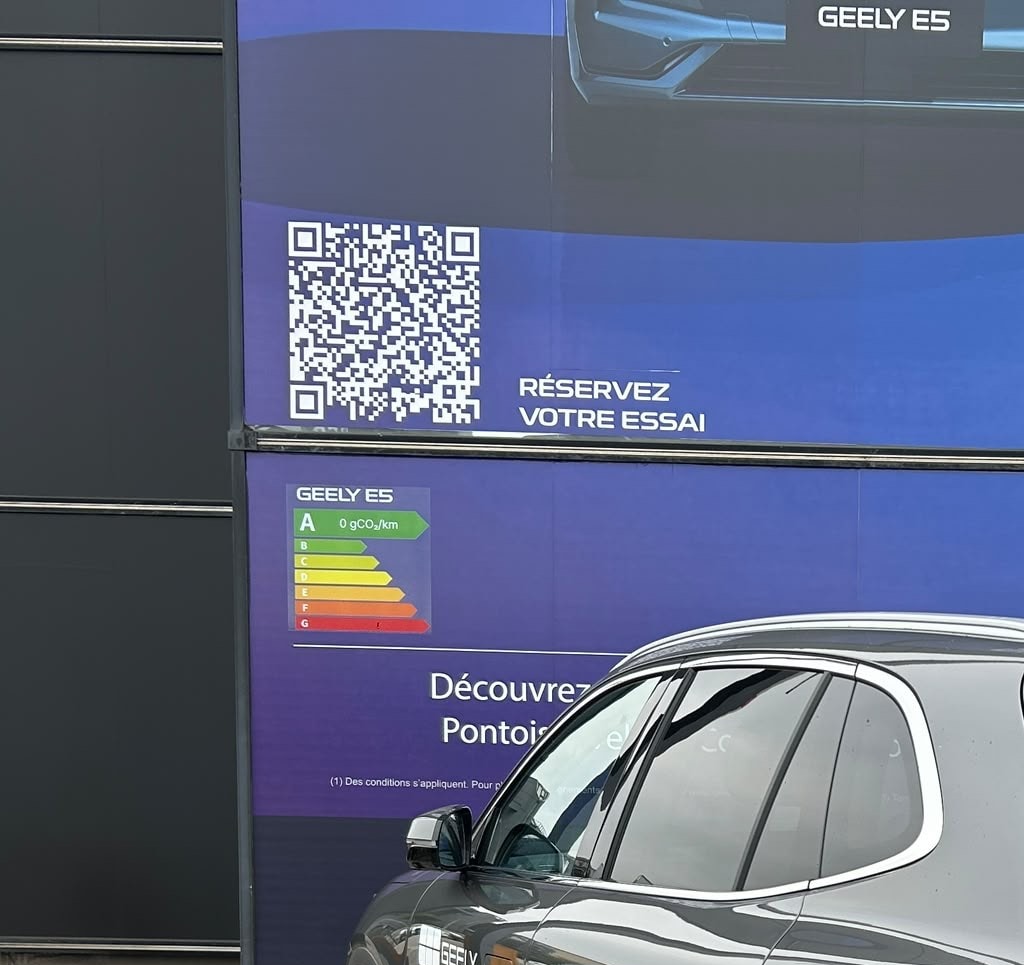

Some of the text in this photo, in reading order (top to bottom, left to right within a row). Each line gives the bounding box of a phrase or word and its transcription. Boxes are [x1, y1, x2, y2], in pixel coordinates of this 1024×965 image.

[818, 5, 951, 32] GEELY E5
[519, 373, 670, 402] RÉSERVEZ
[518, 406, 705, 432] VOTRE ESSAI
[296, 487, 394, 503] GEELY E5
[299, 512, 316, 532] A
[339, 518, 347, 529] 0
[300, 540, 308, 550] B
[300, 556, 308, 566] C
[300, 572, 308, 581] D
[302, 588, 308, 597] E
[302, 603, 309, 612] F
[300, 619, 309, 628] G
[330, 776, 343, 787] (1)
[345, 777, 363, 786] Des
[365, 777, 411, 788] conditions
[471, 780, 493, 790] Pour
